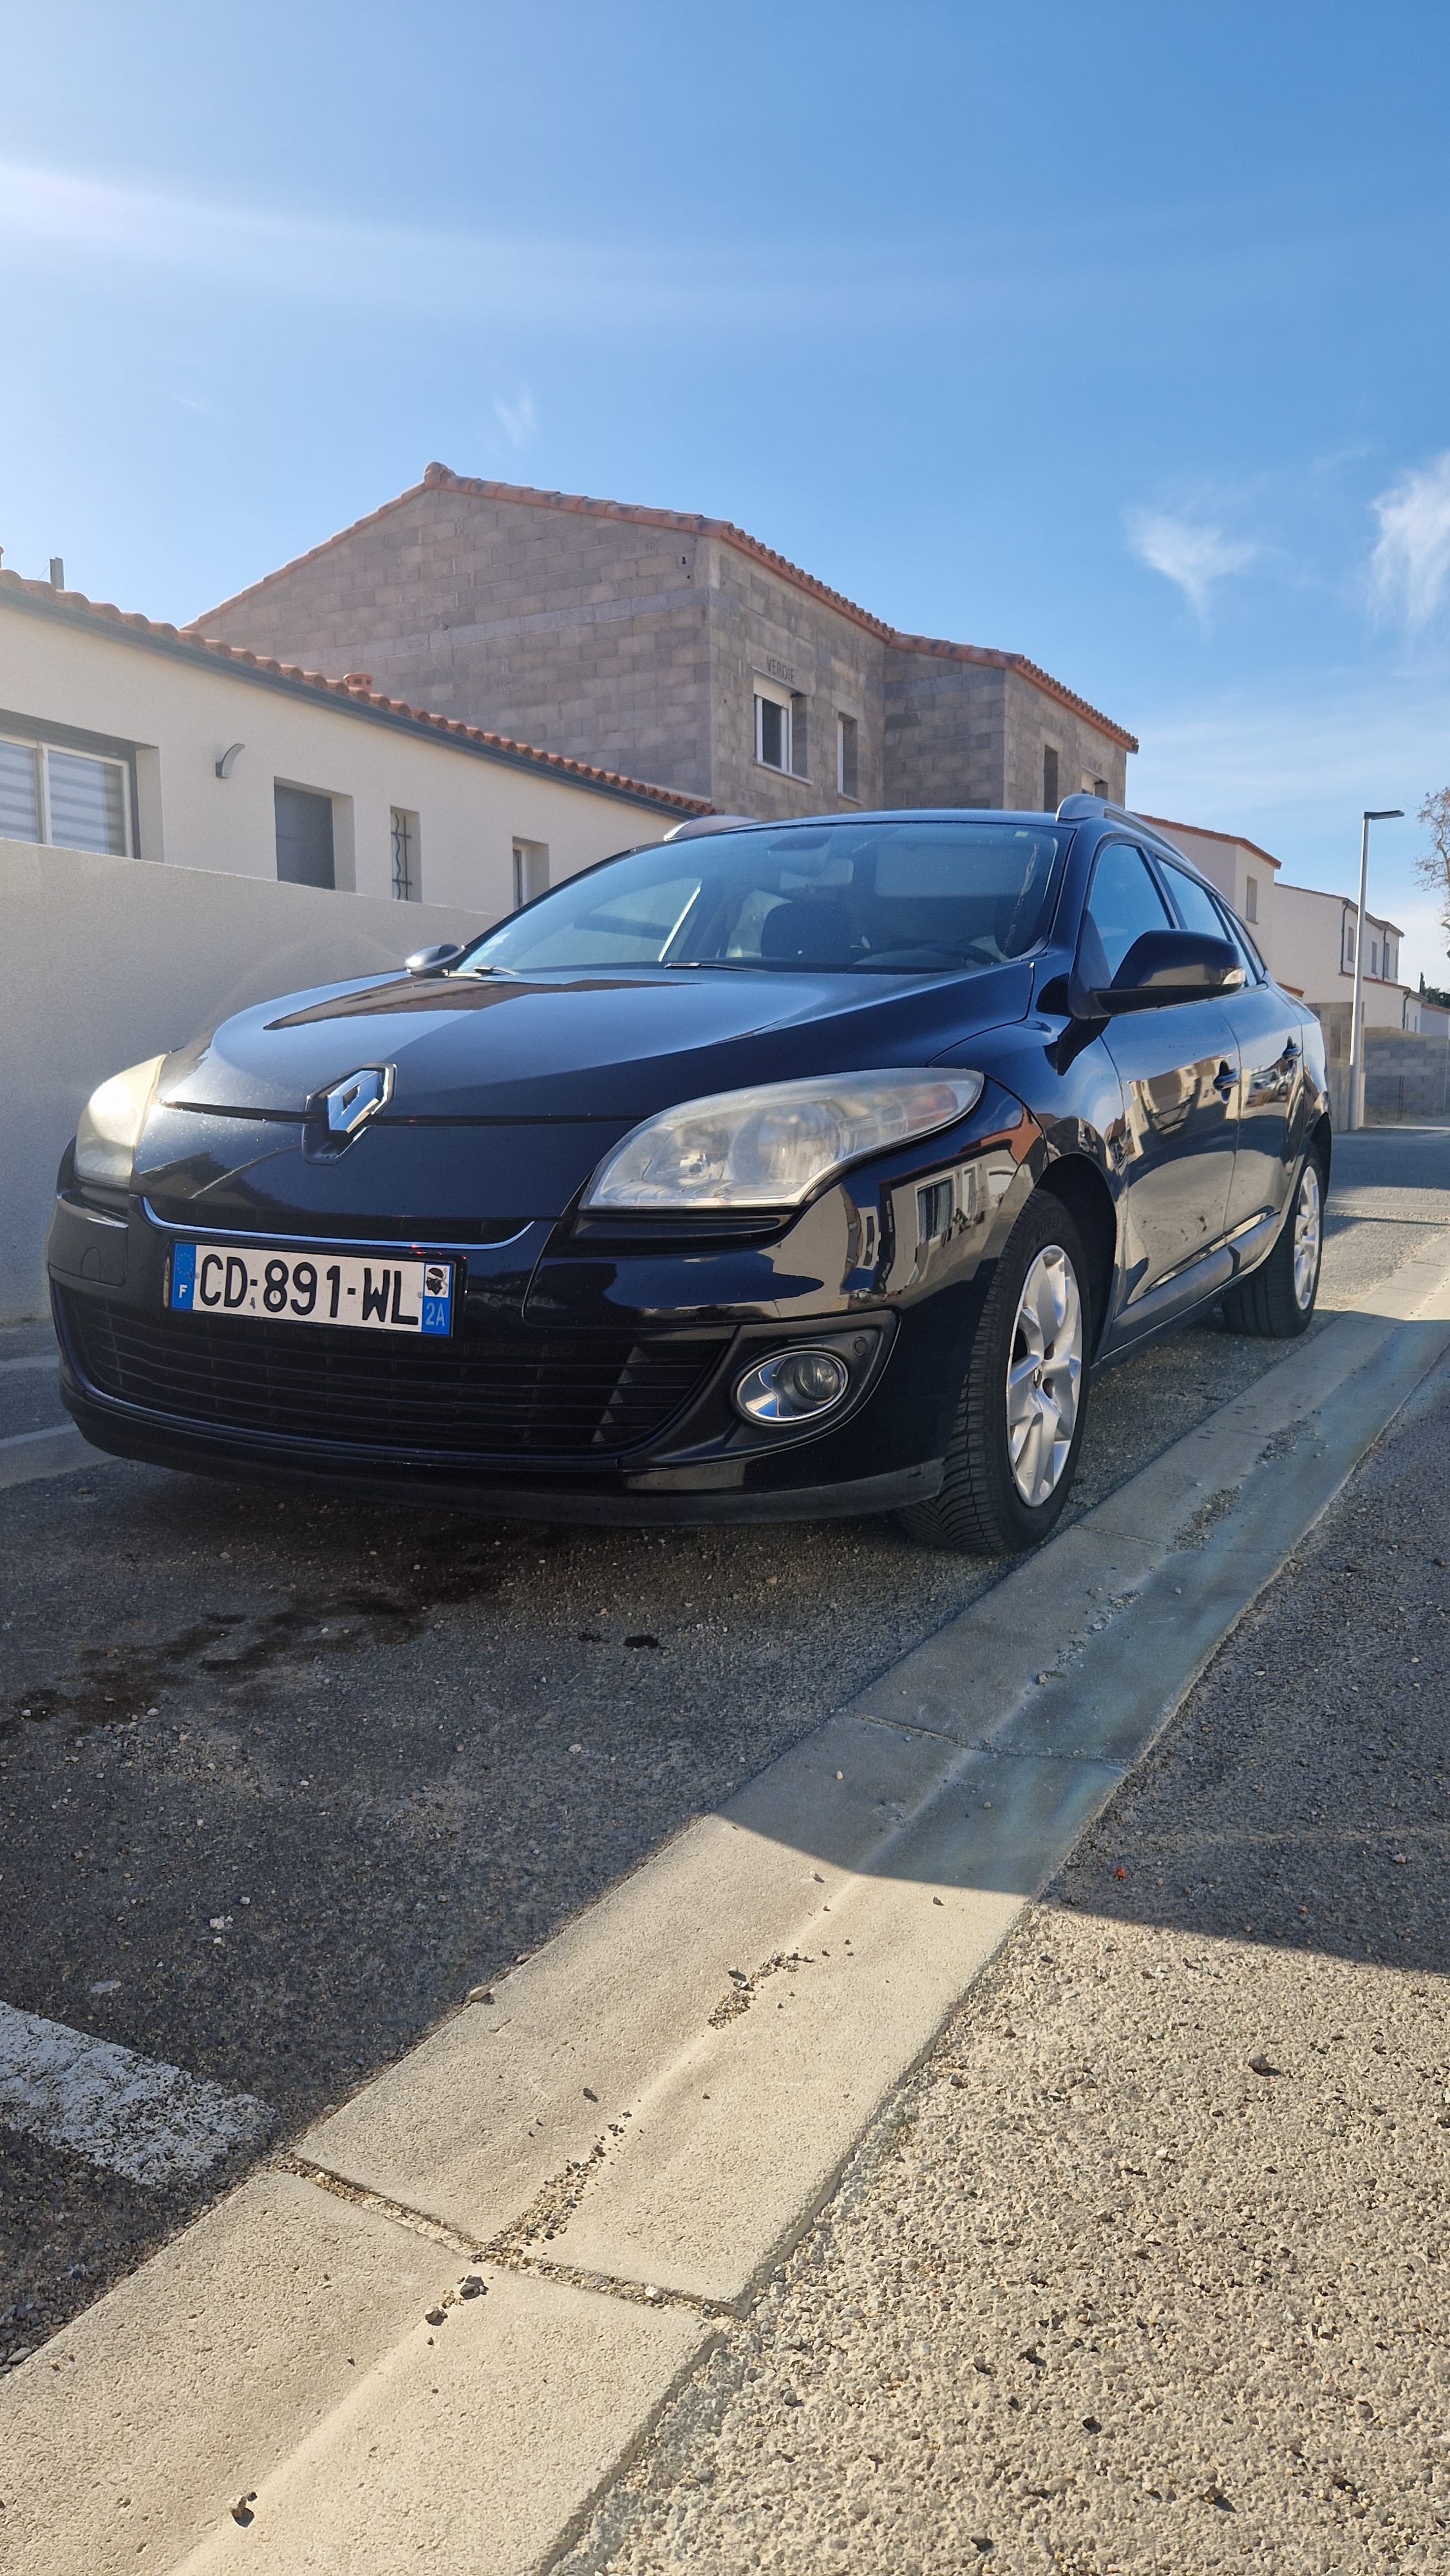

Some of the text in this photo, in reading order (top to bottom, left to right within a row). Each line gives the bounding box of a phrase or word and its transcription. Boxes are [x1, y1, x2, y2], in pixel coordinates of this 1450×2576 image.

[179, 1284, 188, 1299] F
[200, 1254, 419, 1325] CD-891-WL
[425, 1302, 446, 1327] 2A
